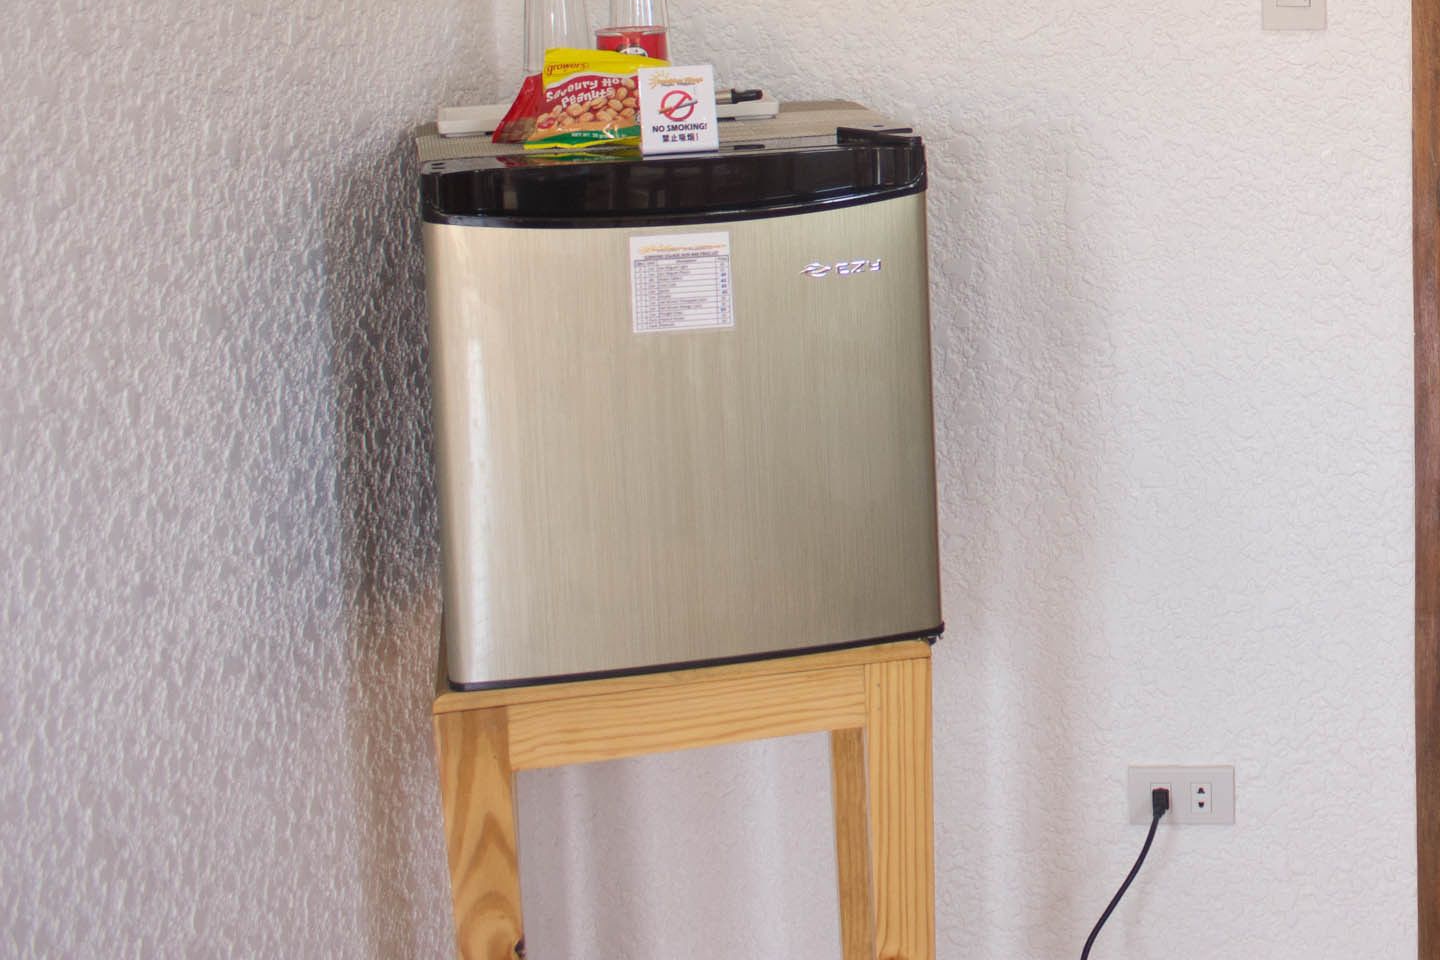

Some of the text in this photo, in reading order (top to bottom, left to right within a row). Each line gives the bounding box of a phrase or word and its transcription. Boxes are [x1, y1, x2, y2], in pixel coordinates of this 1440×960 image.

[546, 80, 599, 103] Savoury
[561, 87, 616, 109] Peanuts
[652, 123, 708, 134] NO SMOKING!
